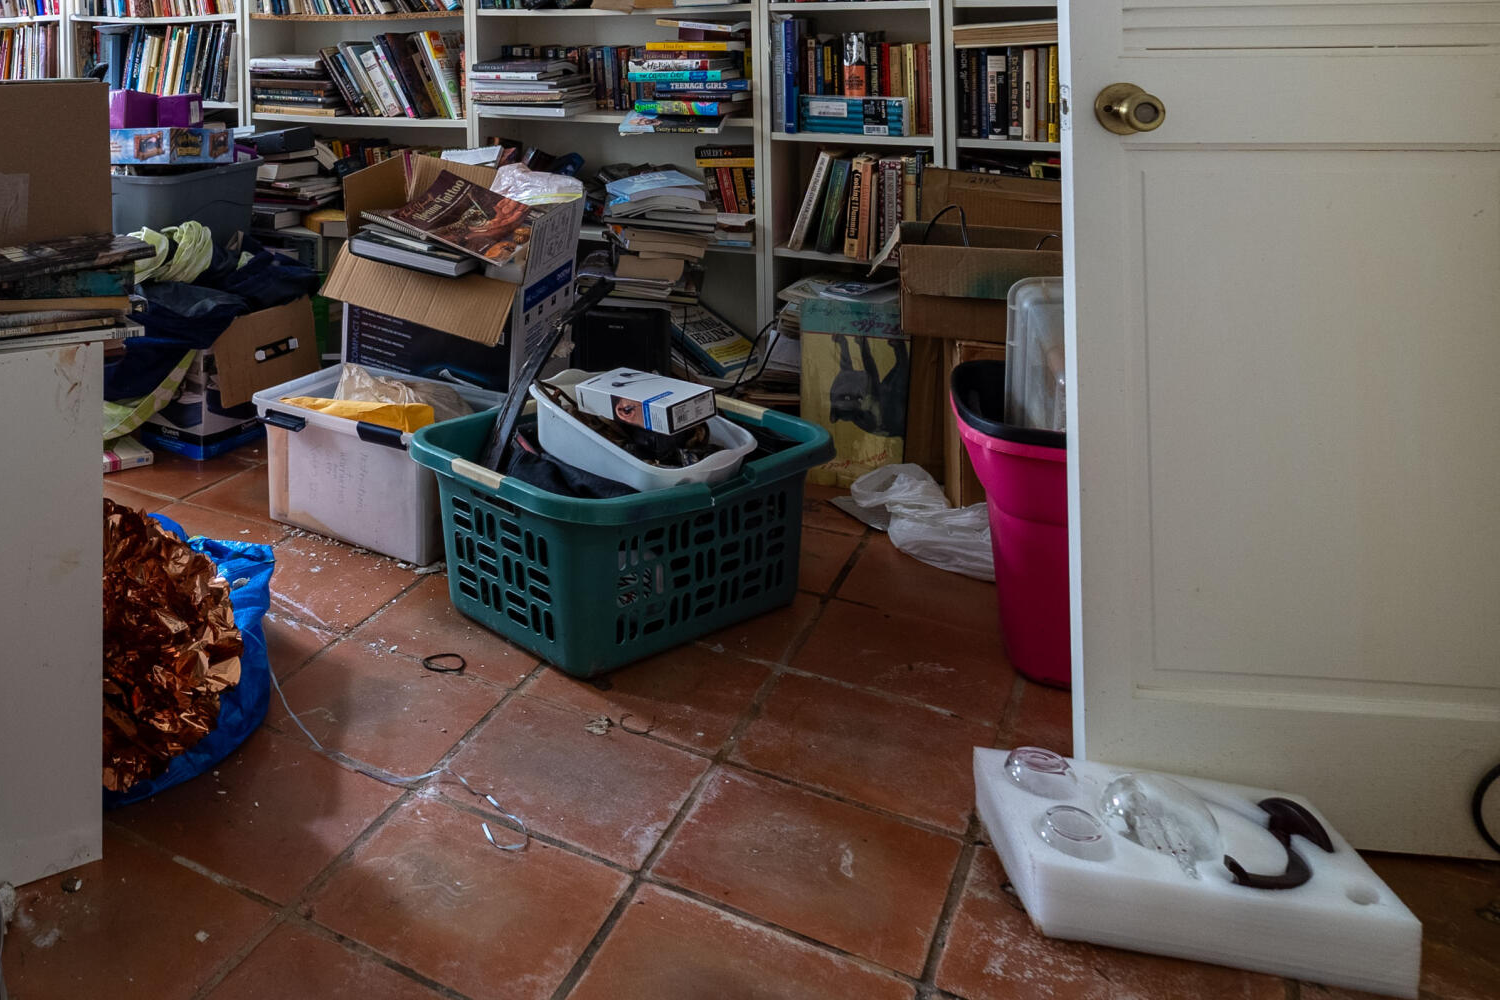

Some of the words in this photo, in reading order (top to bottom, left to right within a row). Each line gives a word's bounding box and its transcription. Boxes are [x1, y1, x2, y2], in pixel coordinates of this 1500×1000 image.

[412, 199, 440, 223] Henna
[433, 179, 466, 207] Tattoo
[848, 205, 858, 238] Dummies
